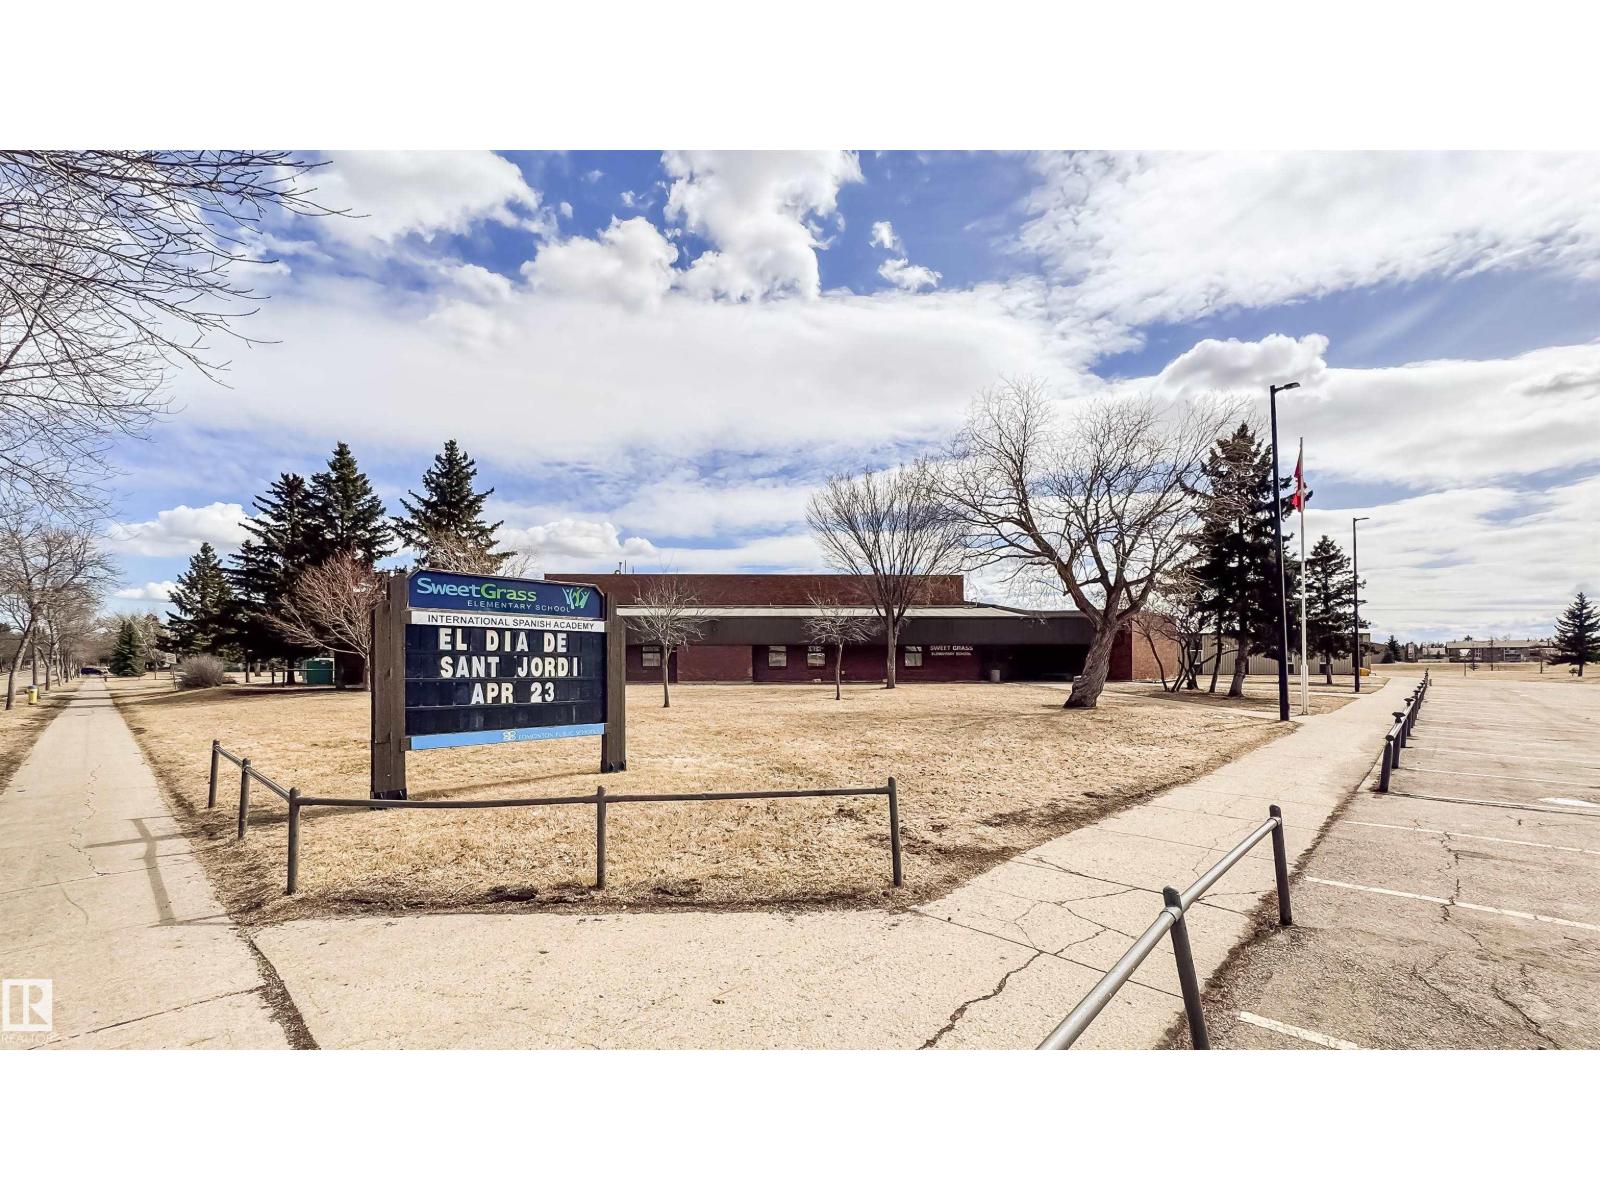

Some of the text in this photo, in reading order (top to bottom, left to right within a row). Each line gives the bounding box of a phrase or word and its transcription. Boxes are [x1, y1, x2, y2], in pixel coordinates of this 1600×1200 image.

[416, 577, 537, 602] SweetGrass
[467, 600, 571, 613] ELEMENTARY SCHOOL
[428, 614, 594, 630] INTERNATIONAL SPANISH ACADEMY
[439, 628, 568, 653] EL DIA DE
[440, 655, 578, 678] SANT JORDI
[471, 682, 555, 705] APR 23
